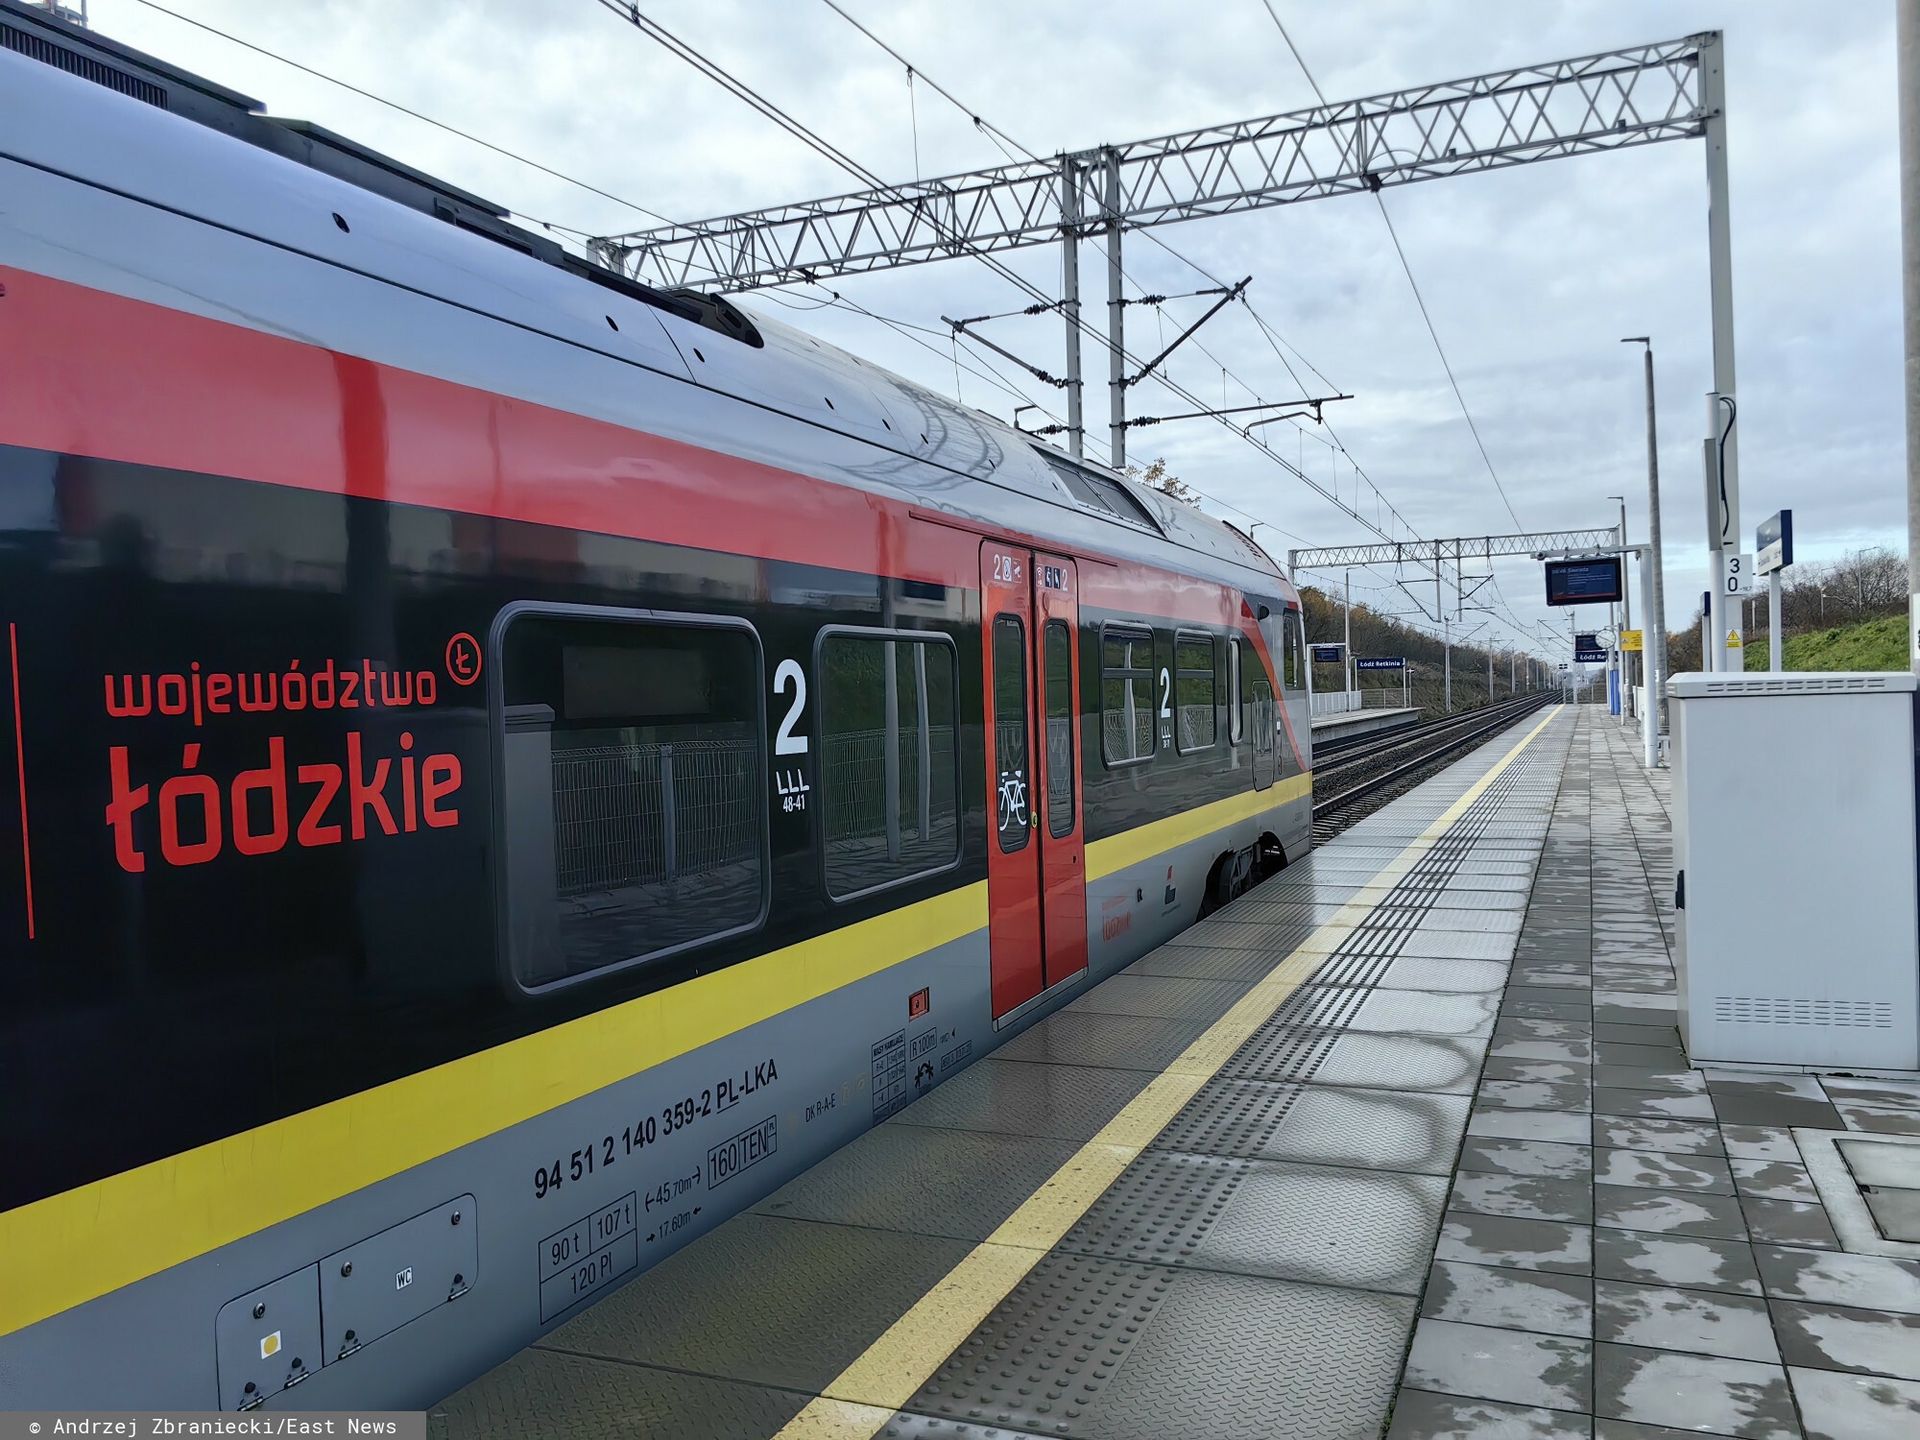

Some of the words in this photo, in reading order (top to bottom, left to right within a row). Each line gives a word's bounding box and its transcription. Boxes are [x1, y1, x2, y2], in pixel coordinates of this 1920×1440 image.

[993, 554, 1001, 580] 2
[1062, 569, 1068, 592] 2
[1729, 558, 1740, 574] 3
[1728, 577, 1738, 592] 0
[103, 659, 437, 726] województwo
[773, 658, 808, 756] 2
[1160, 667, 1171, 718] 2
[105, 731, 462, 873] łódzkie
[782, 795, 805, 813] 48-41
[912, 1041, 917, 1057] R
[534, 1159, 563, 1199] 94
[570, 1144, 594, 1182] 51
[602, 1135, 615, 1167] 2
[622, 1116, 656, 1155] 140
[662, 1090, 711, 1135] 359-2
[716, 1058, 778, 1111] PL-LKA
[711, 1143, 737, 1180] 160
[740, 1125, 767, 1164] TEN
[655, 1176, 692, 1208] 45.70m
[597, 1210, 621, 1240] 107
[625, 1207, 631, 1225] t
[659, 1211, 691, 1239] 17.60m
[552, 1237, 569, 1266] 90
[573, 1232, 580, 1254] t
[398, 1269, 412, 1287] WC
[570, 1262, 596, 1295] 120
